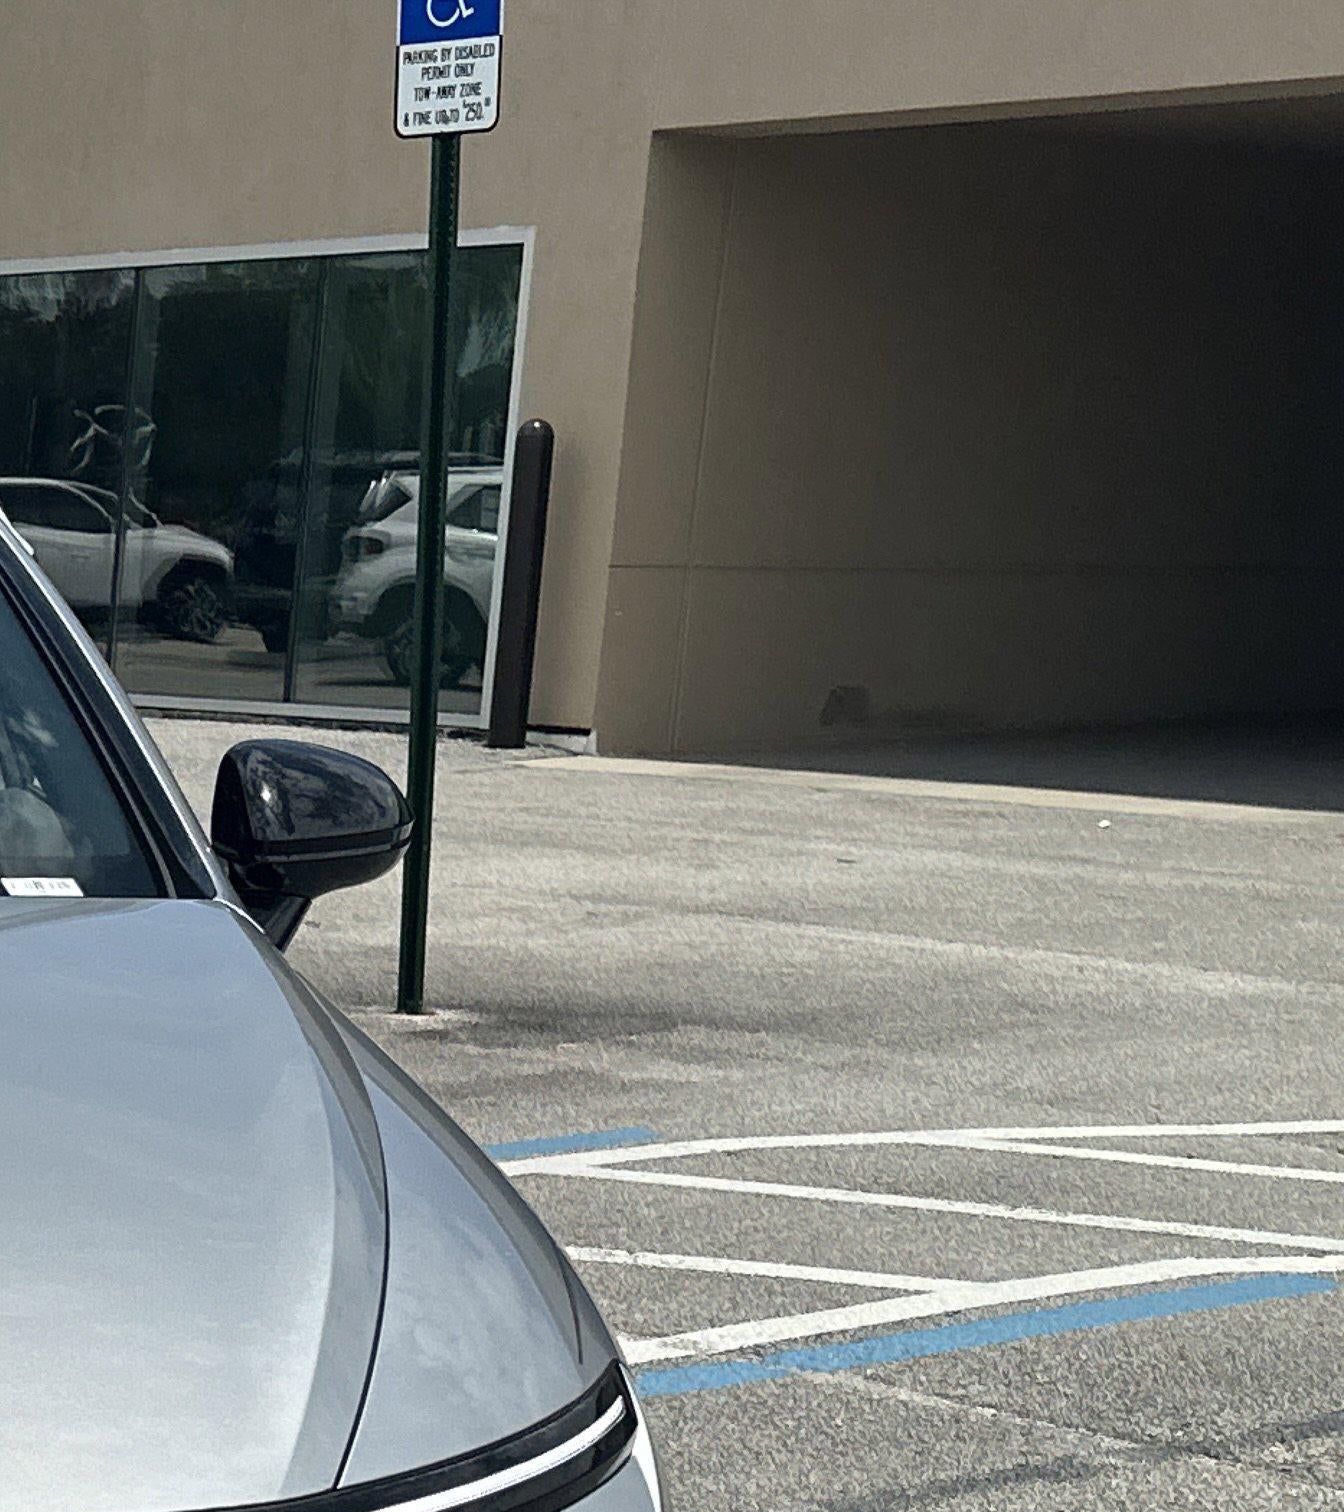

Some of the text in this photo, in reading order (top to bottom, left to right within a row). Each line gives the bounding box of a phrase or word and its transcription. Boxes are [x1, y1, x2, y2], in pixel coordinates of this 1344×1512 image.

[455, 43, 495, 60] DISABLED
[421, 63, 475, 80] PERMIT ONLY
[459, 82, 482, 98] ZONE
